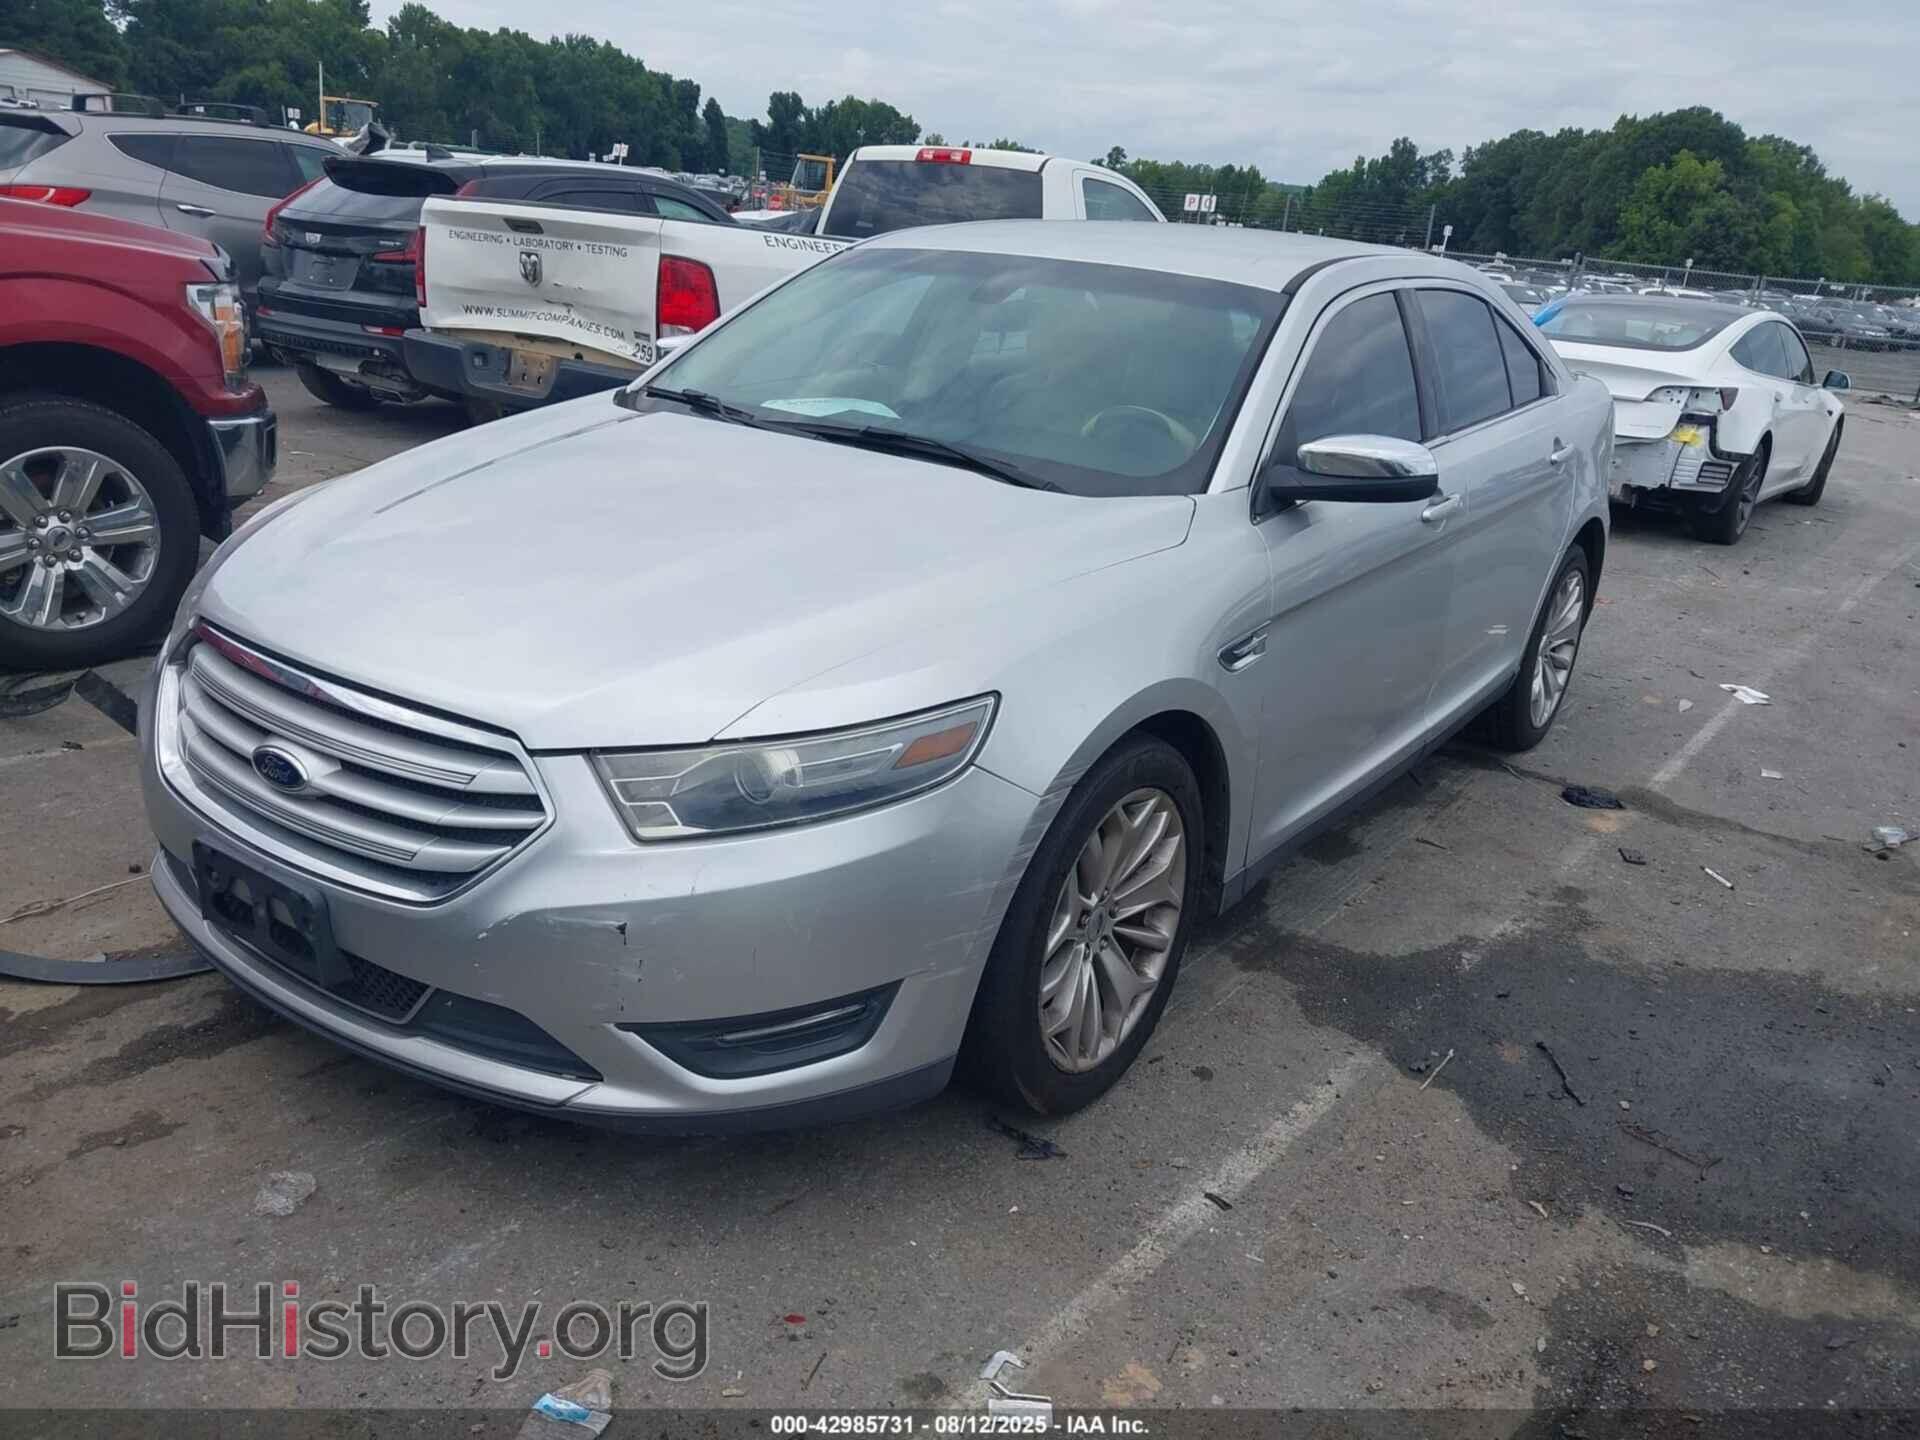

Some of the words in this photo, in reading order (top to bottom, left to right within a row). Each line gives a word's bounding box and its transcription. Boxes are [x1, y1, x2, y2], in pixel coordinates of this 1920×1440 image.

[449, 229, 503, 244] ENGINEERING
[513, 237, 574, 251] LABORATORY
[585, 243, 627, 257] TESTING
[763, 235, 845, 254] ENGINEER
[632, 342, 653, 362] 259
